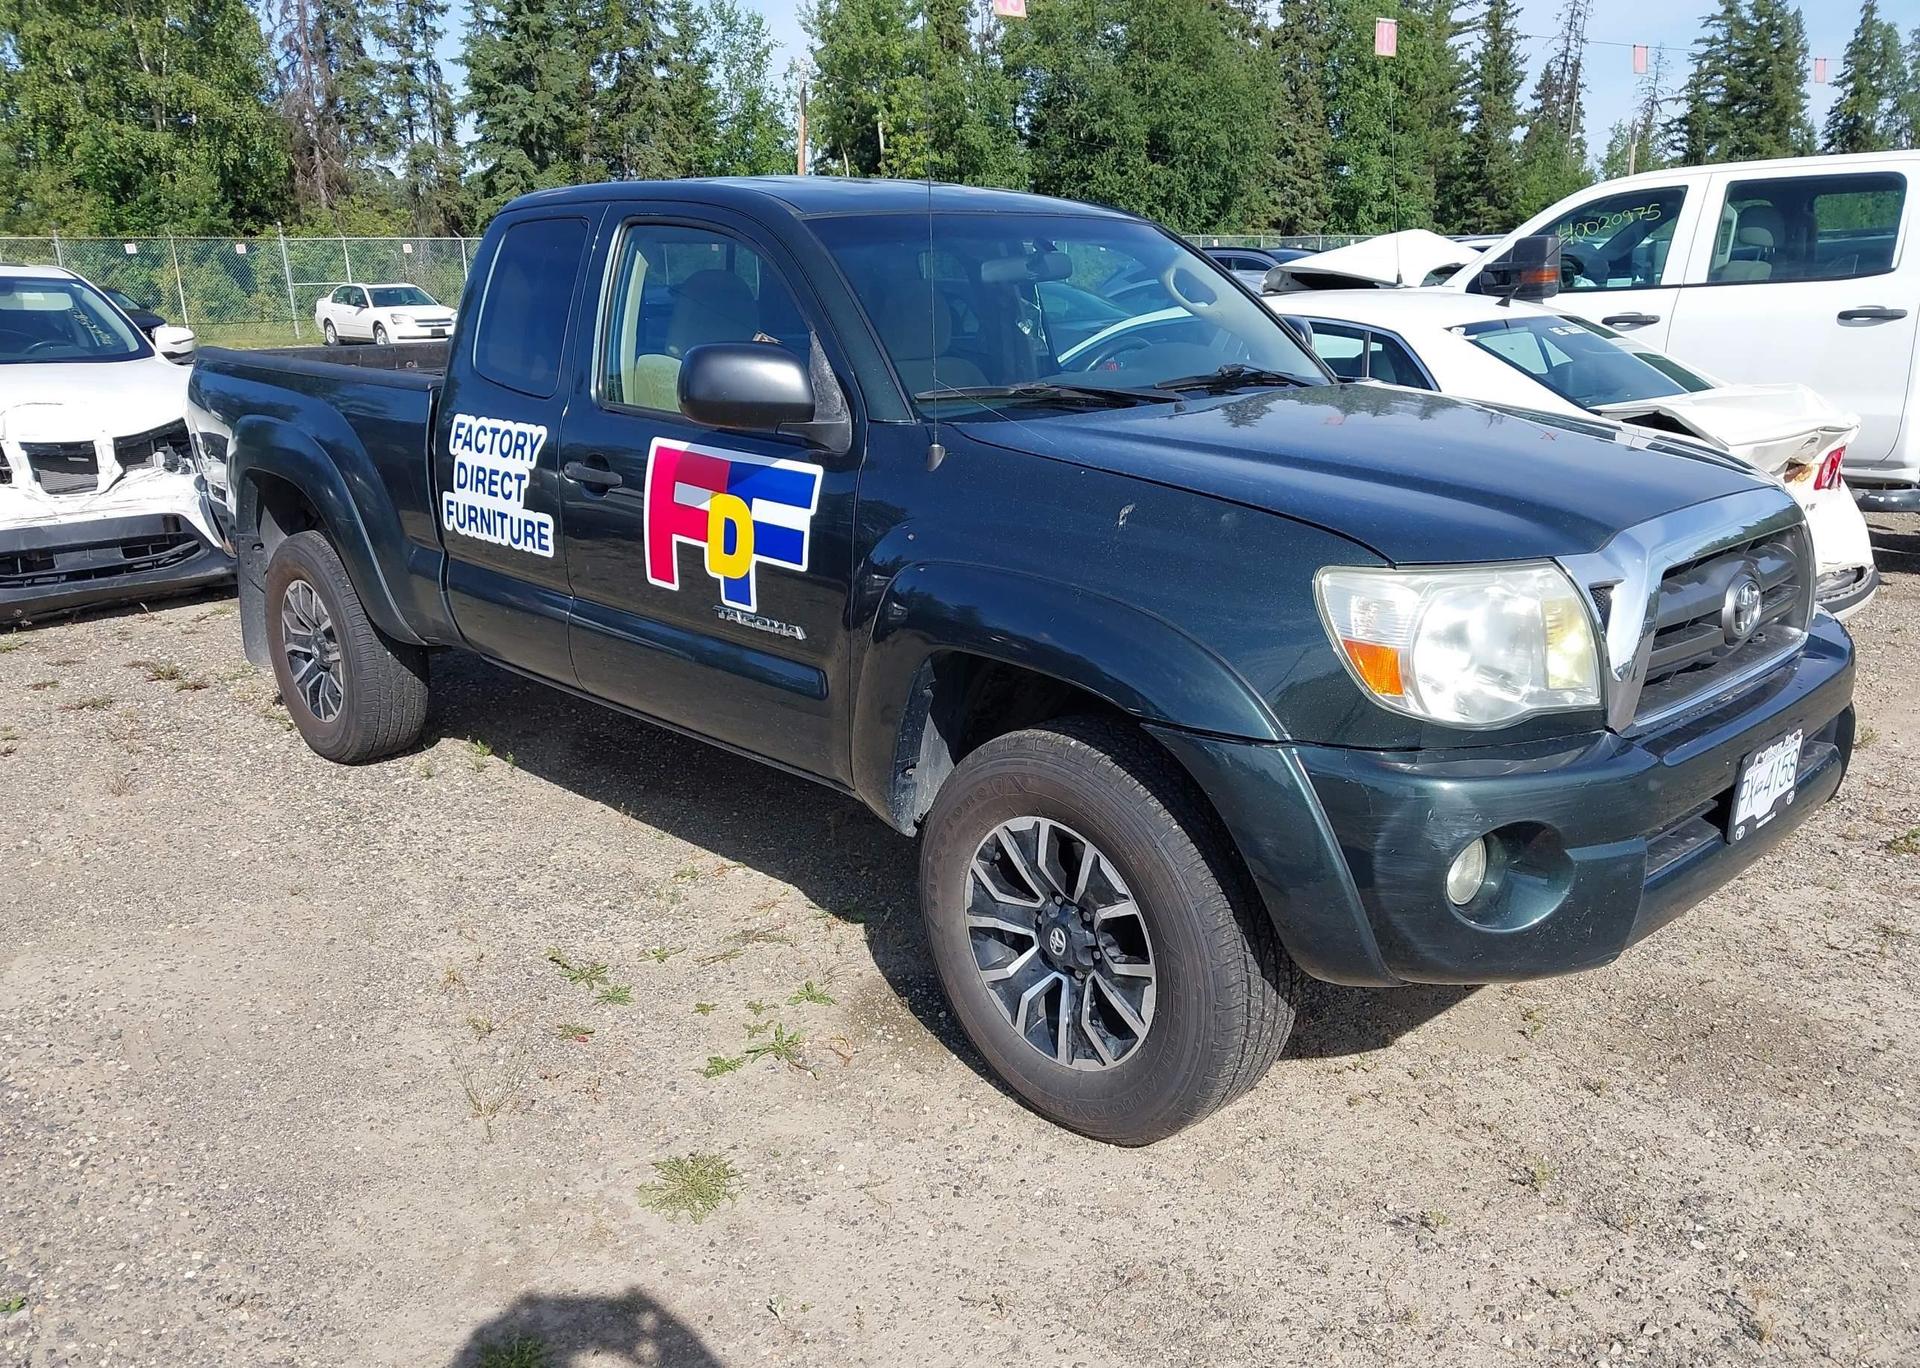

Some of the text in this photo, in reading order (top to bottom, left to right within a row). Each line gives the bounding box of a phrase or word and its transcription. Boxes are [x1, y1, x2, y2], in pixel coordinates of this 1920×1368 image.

[452, 421, 543, 463] FACTORY
[456, 461, 526, 503] DIRECT
[446, 499, 550, 552] FURNITURE
[712, 604, 808, 640] TACOMA
[1763, 748, 1799, 798] 4158
